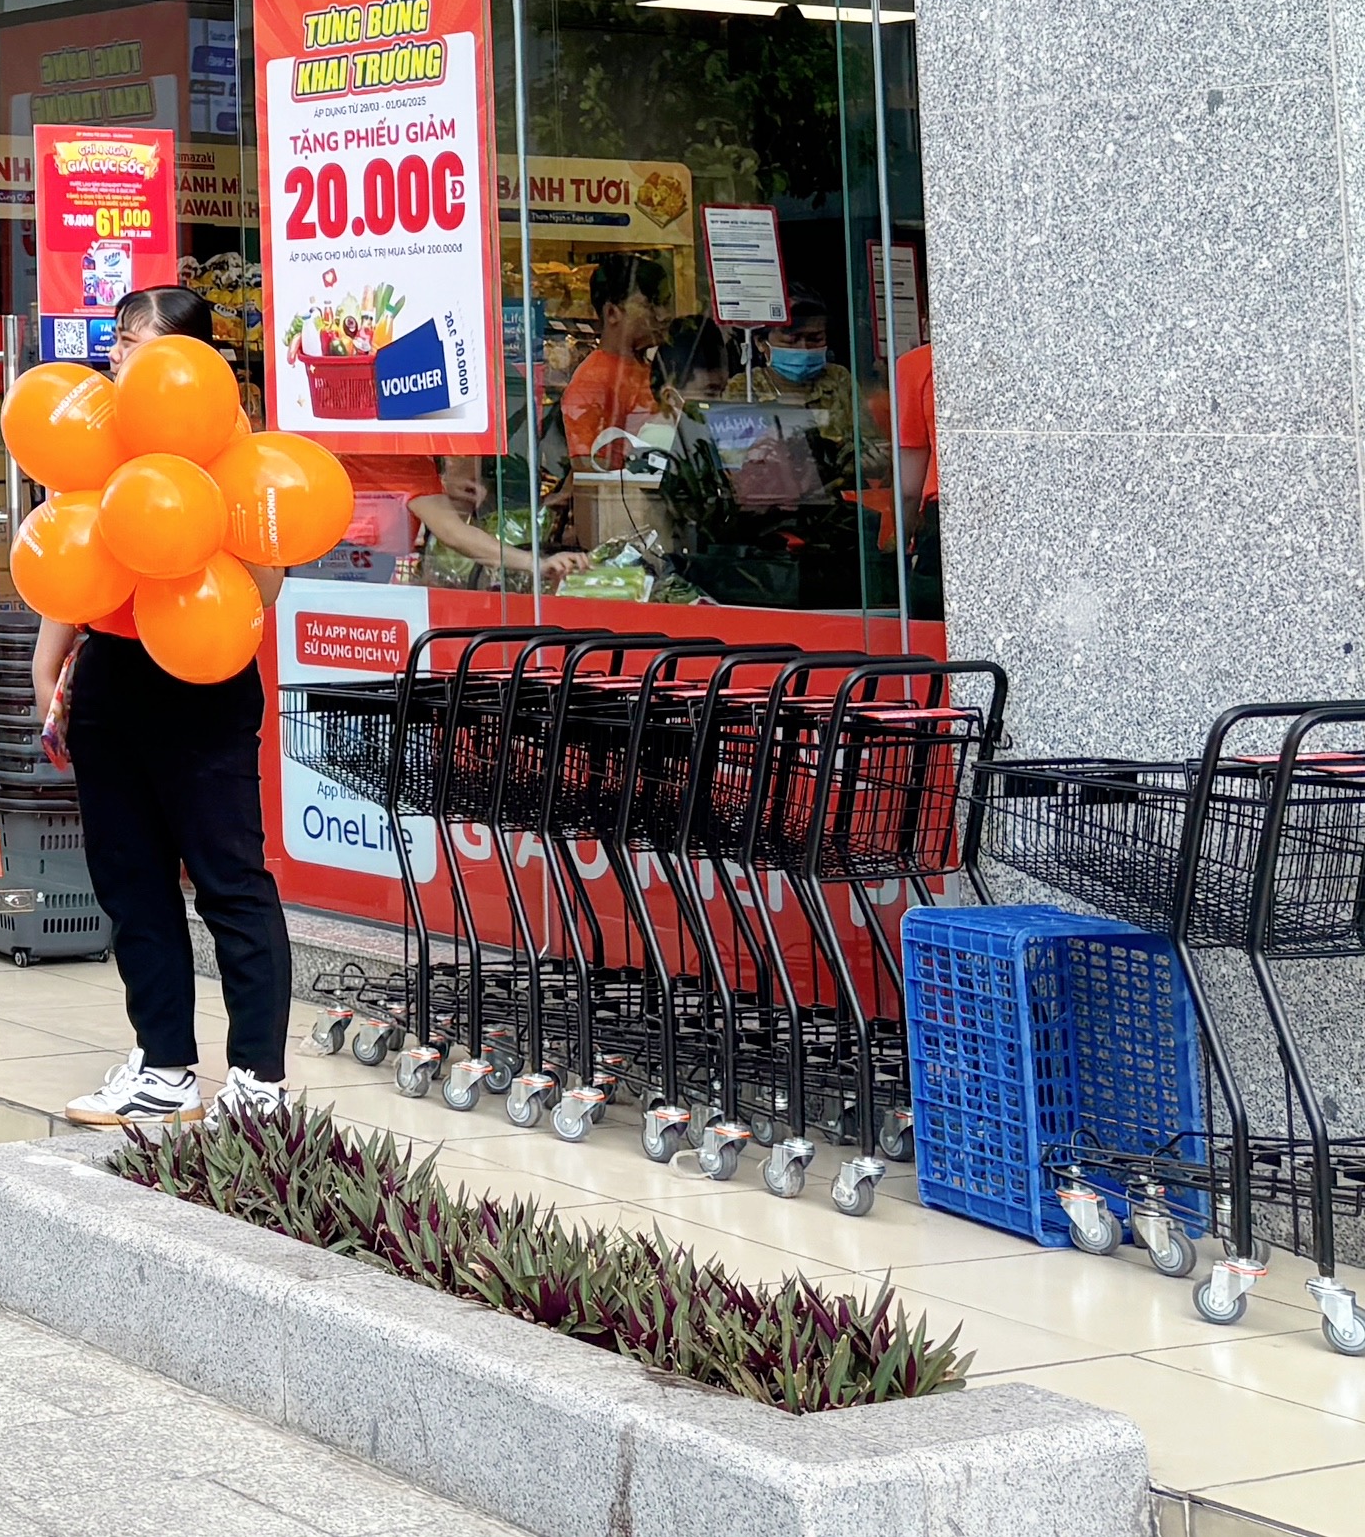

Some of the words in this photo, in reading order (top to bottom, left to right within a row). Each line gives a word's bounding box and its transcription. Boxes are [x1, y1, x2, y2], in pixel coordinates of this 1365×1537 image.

[305, 6, 361, 49] TƯNG
[295, 54, 348, 96] KHAI
[353, 41, 442, 88] TRƯƠNG
[289, 128, 338, 160] TẶNG
[344, 117, 399, 150] PHIẾU
[406, 114, 456, 144] GIẢM
[68, 158, 89, 173] GIÁ
[91, 159, 117, 174] CỰC
[119, 157, 145, 175] SỐC
[569, 176, 631, 206] TƯƠI
[95, 208, 152, 238] 61.000
[324, 249, 342, 260] CHO
[388, 245, 406, 256] MUA
[381, 369, 442, 396] VOUCHER
[306, 620, 322, 637] TẢI
[325, 625, 347, 640] APP
[349, 627, 379, 642] NGAY
[321, 642, 352, 660] DỤNG
[354, 646, 382, 663] DỊCH
[384, 649, 401, 667] VỤ
[317, 781, 339, 802] App
